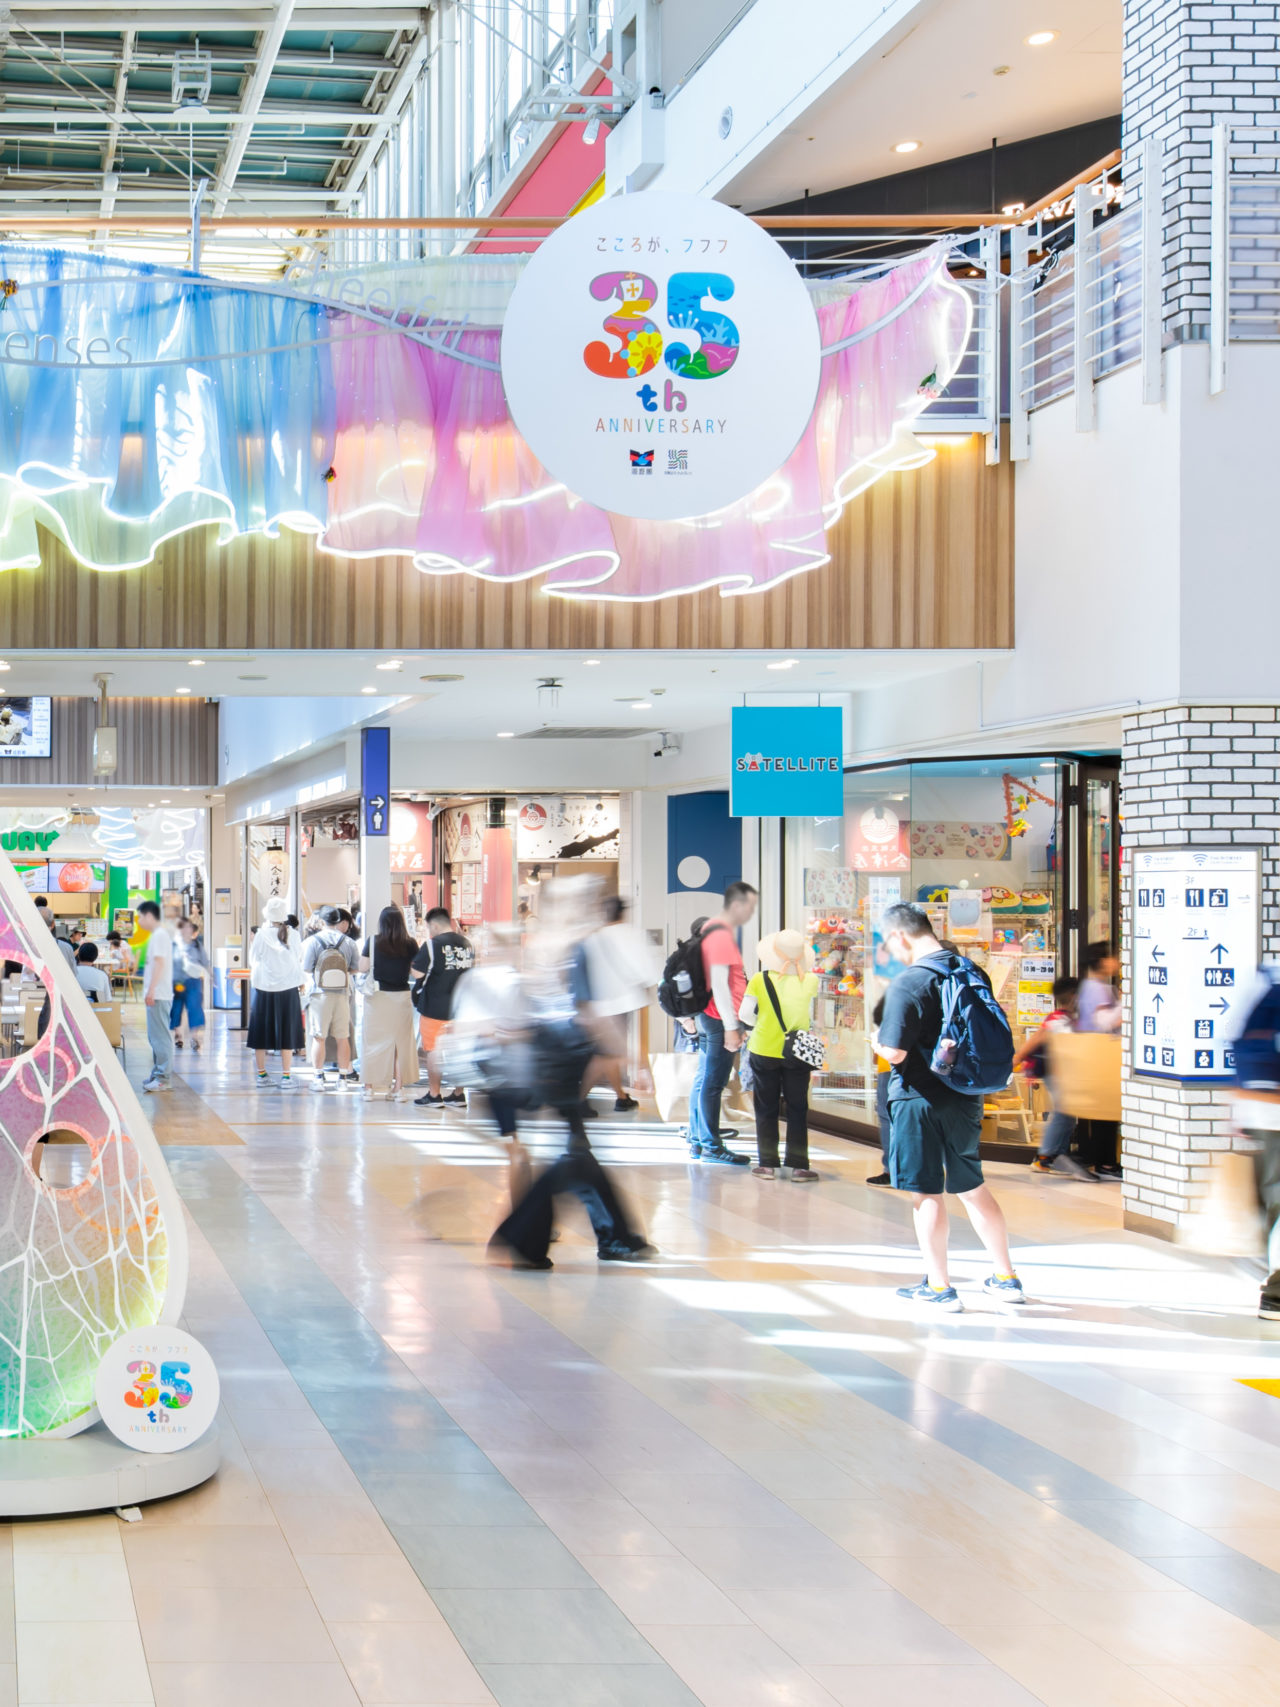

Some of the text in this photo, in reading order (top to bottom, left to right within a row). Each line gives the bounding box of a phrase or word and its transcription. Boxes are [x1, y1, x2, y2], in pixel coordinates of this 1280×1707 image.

[284, 253, 470, 352] cheerful
[583, 270, 741, 380] 35
[636, 378, 688, 413] th
[595, 416, 728, 434] ANNIVERSARY
[736, 755, 839, 771] SATELLITE
[1185, 875, 1195, 885] 3F
[1187, 927, 1198, 937] 2F
[124, 1360, 193, 1409] 35
[147, 1409, 170, 1423] th
[129, 1425, 187, 1433] ANNIVERSARY
